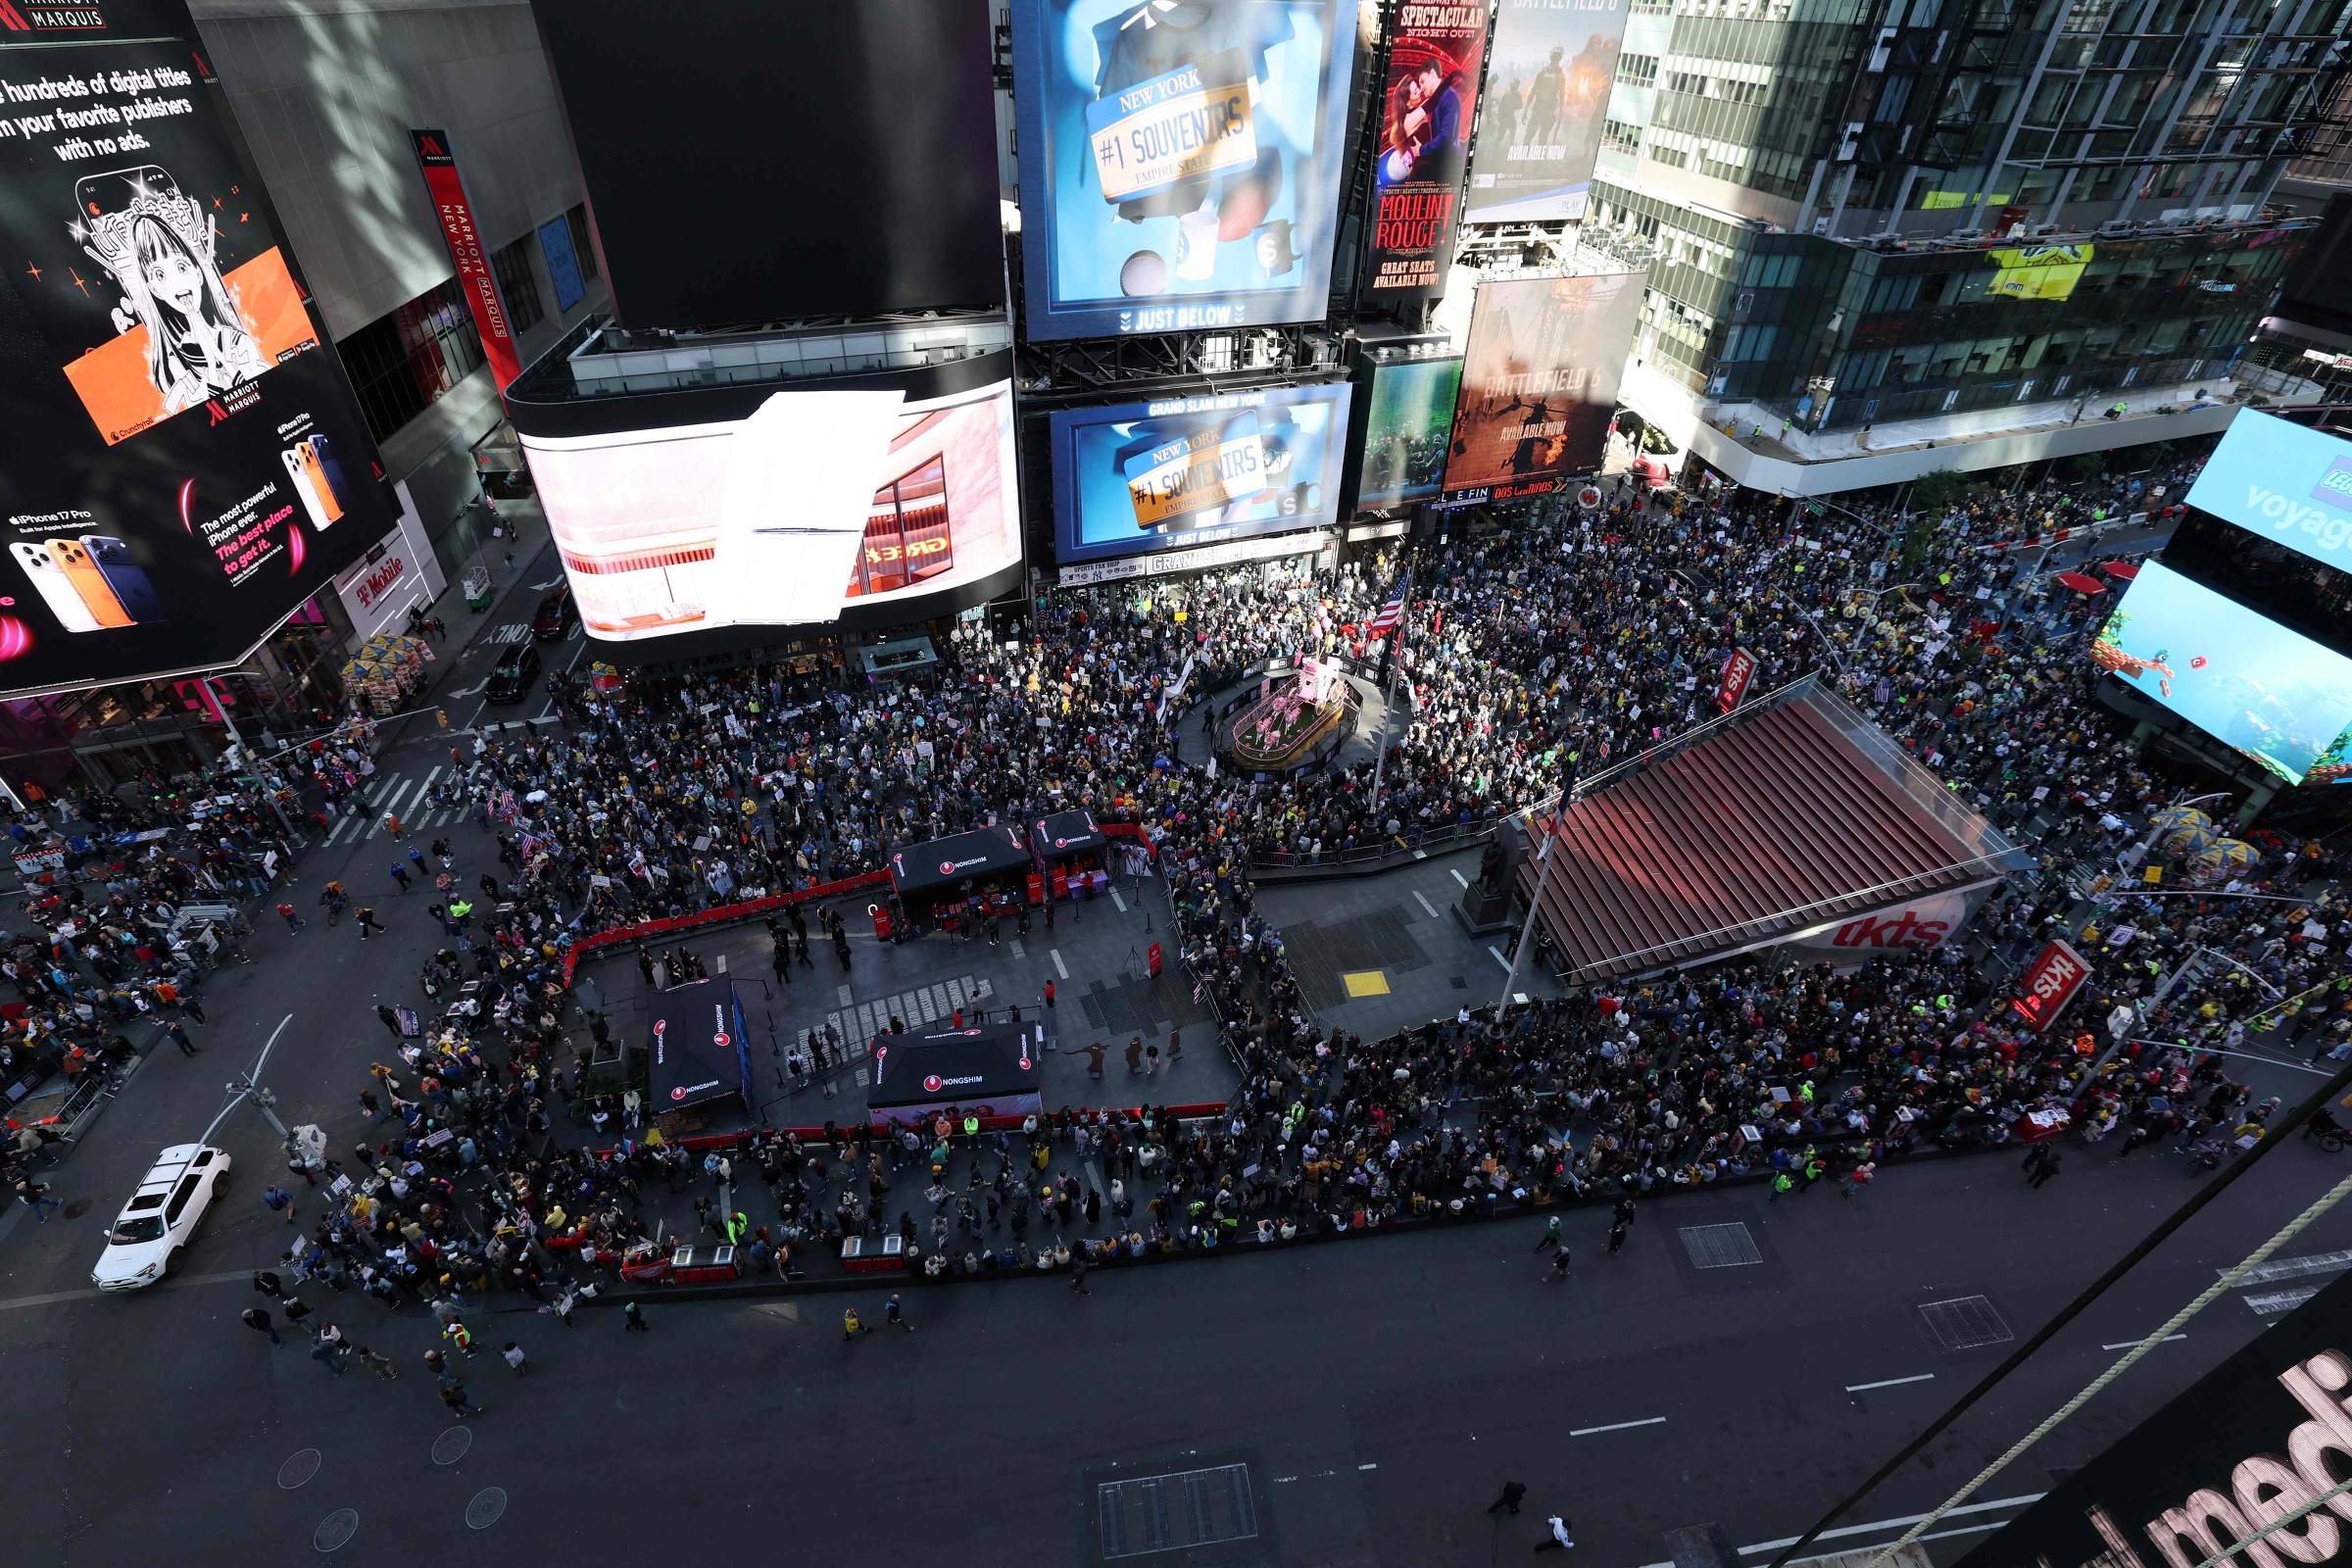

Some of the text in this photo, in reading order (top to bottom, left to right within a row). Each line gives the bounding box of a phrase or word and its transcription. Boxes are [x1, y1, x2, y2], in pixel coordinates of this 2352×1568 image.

[31, 10, 103, 27] MARQUIS
[1400, 7, 1484, 27] SPECTACULAR
[1406, 28, 1448, 38] NIGHT
[1, 67, 191, 102] hundreds of digital titles
[1119, 69, 1202, 114] NEW YORK
[14, 115, 56, 139] your
[57, 104, 121, 129] favorite
[121, 97, 192, 125] publishers
[1100, 96, 1245, 170] #1 SOUVENIRS
[53, 129, 150, 161] with no ads.
[1507, 145, 1567, 161] AVAILABLE NOW
[1136, 153, 1211, 184] EMPIRE STATE
[1380, 195, 1443, 221] MOULIN
[442, 205, 471, 274] NEW YORK
[455, 205, 506, 336] MARRIOTT MARQUIS
[1381, 261, 1436, 274] GREAT SEATS
[1373, 273, 1440, 288] AVAILABLE NOW!
[1135, 306, 1231, 331] JUST BELOW
[223, 380, 259, 404] MARRIOTT
[1485, 367, 1600, 398] BATTLEFIELD 6
[228, 392, 261, 414] MARQUIS
[1149, 394, 1266, 416] GRAND SLAM NEW YORK
[119, 416, 155, 437] Crunchyroll
[1500, 419, 1567, 441] AVAILABLE NOW
[1152, 429, 1222, 465] NEW YORK
[1134, 445, 1257, 506] #1 SOUVENIRS
[1494, 486, 1512, 499] DOS
[17, 514, 59, 524] iPhone
[71, 510, 91, 519] Pro
[200, 481, 277, 534] The most powerful
[1165, 498, 1194, 514] EMPIRE
[207, 511, 259, 547] iPhone ever.
[216, 505, 293, 561] The best place
[1175, 528, 1230, 546] JUST BELOW
[224, 538, 271, 575] to get it.
[1152, 552, 1202, 573] GRAND
[1074, 564, 1094, 573] SPORTS
[480, 623, 529, 645] ONLY
[1728, 656, 1749, 692] tkts
[1066, 834, 1091, 844] NONGSHIM
[13, 847, 65, 860] CHICAGO
[955, 857, 987, 868] NONGSHIM
[1833, 910, 1949, 950] tkts
[2033, 954, 2077, 1000] tkts
[715, 1004, 724, 1033] NONGSHIM
[686, 1080, 719, 1094] NONGSHIM
[942, 1075, 983, 1086] NONGSHIM
